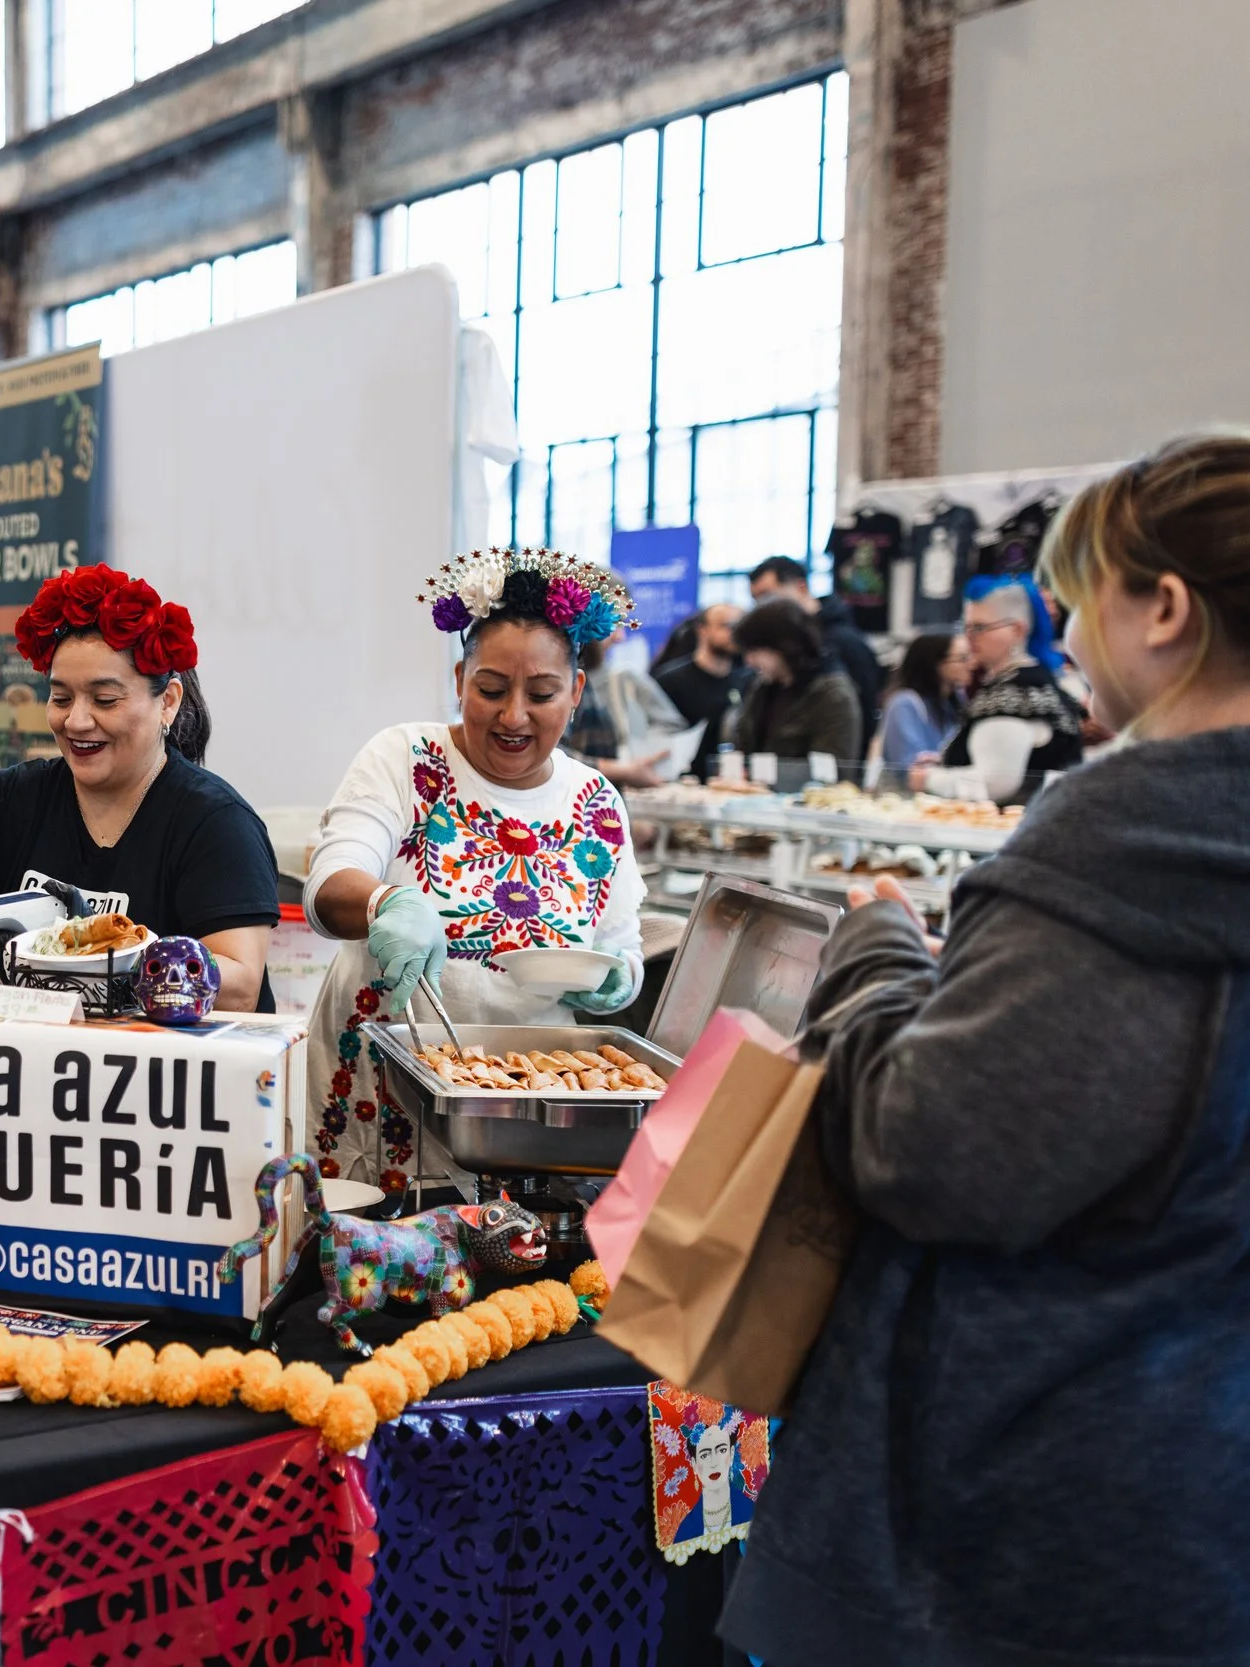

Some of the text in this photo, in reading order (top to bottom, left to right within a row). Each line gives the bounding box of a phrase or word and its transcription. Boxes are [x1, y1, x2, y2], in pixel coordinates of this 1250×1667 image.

[3, 539, 80, 583] BOWLS
[50, 1324, 103, 1336] MENU
[97, 1541, 290, 1630] CINCO
